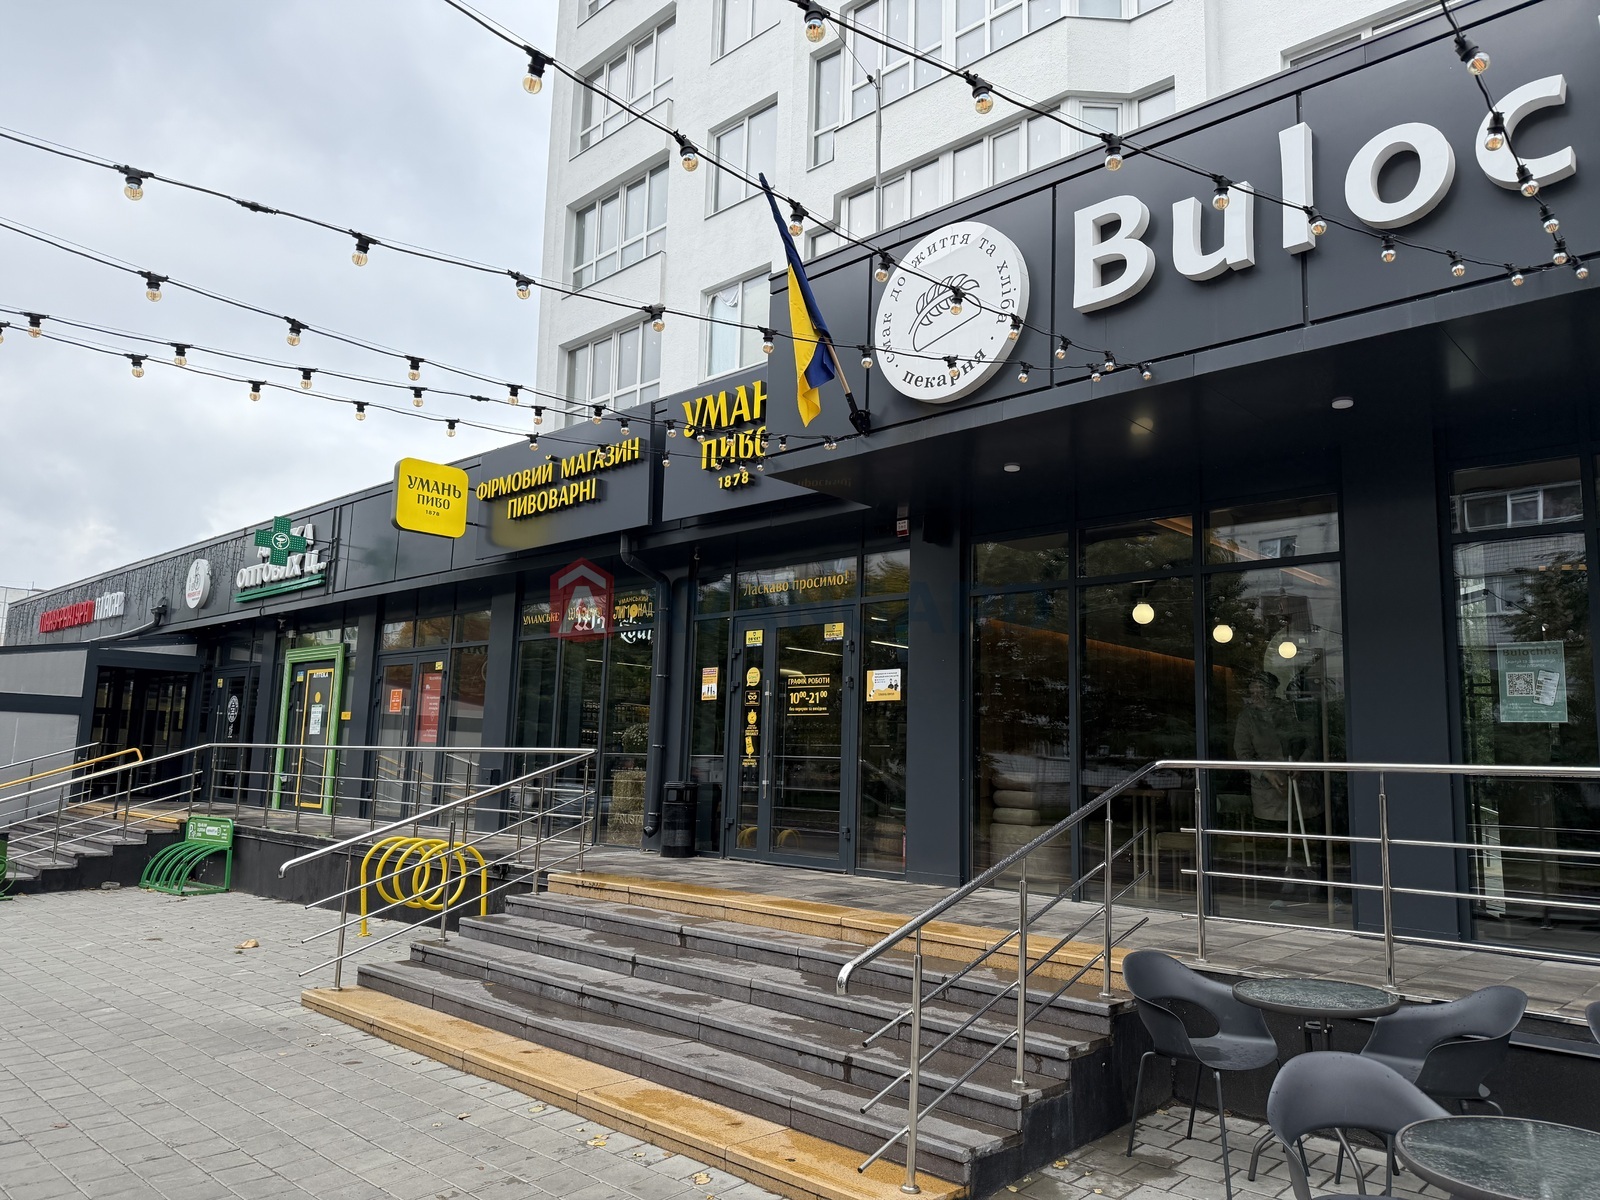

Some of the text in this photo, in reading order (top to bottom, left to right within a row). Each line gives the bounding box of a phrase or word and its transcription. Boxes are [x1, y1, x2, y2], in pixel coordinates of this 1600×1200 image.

[1073, 14, 1600, 314] Buloc
[881, 233, 1018, 364] смак до життя та хліба
[902, 348, 987, 388] пекарня
[475, 436, 640, 501] ФІРМОВИЙ МАГАЗИН
[718, 471, 749, 489] 1878
[407, 475, 462, 499] УМАНЬ
[506, 477, 597, 520] ПИВОВАРНІ
[417, 494, 451, 510] ПИВО
[425, 509, 440, 517] 1878
[743, 569, 849, 596] Ласкаво просимо!
[807, 676, 830, 684] РОБОТИ
